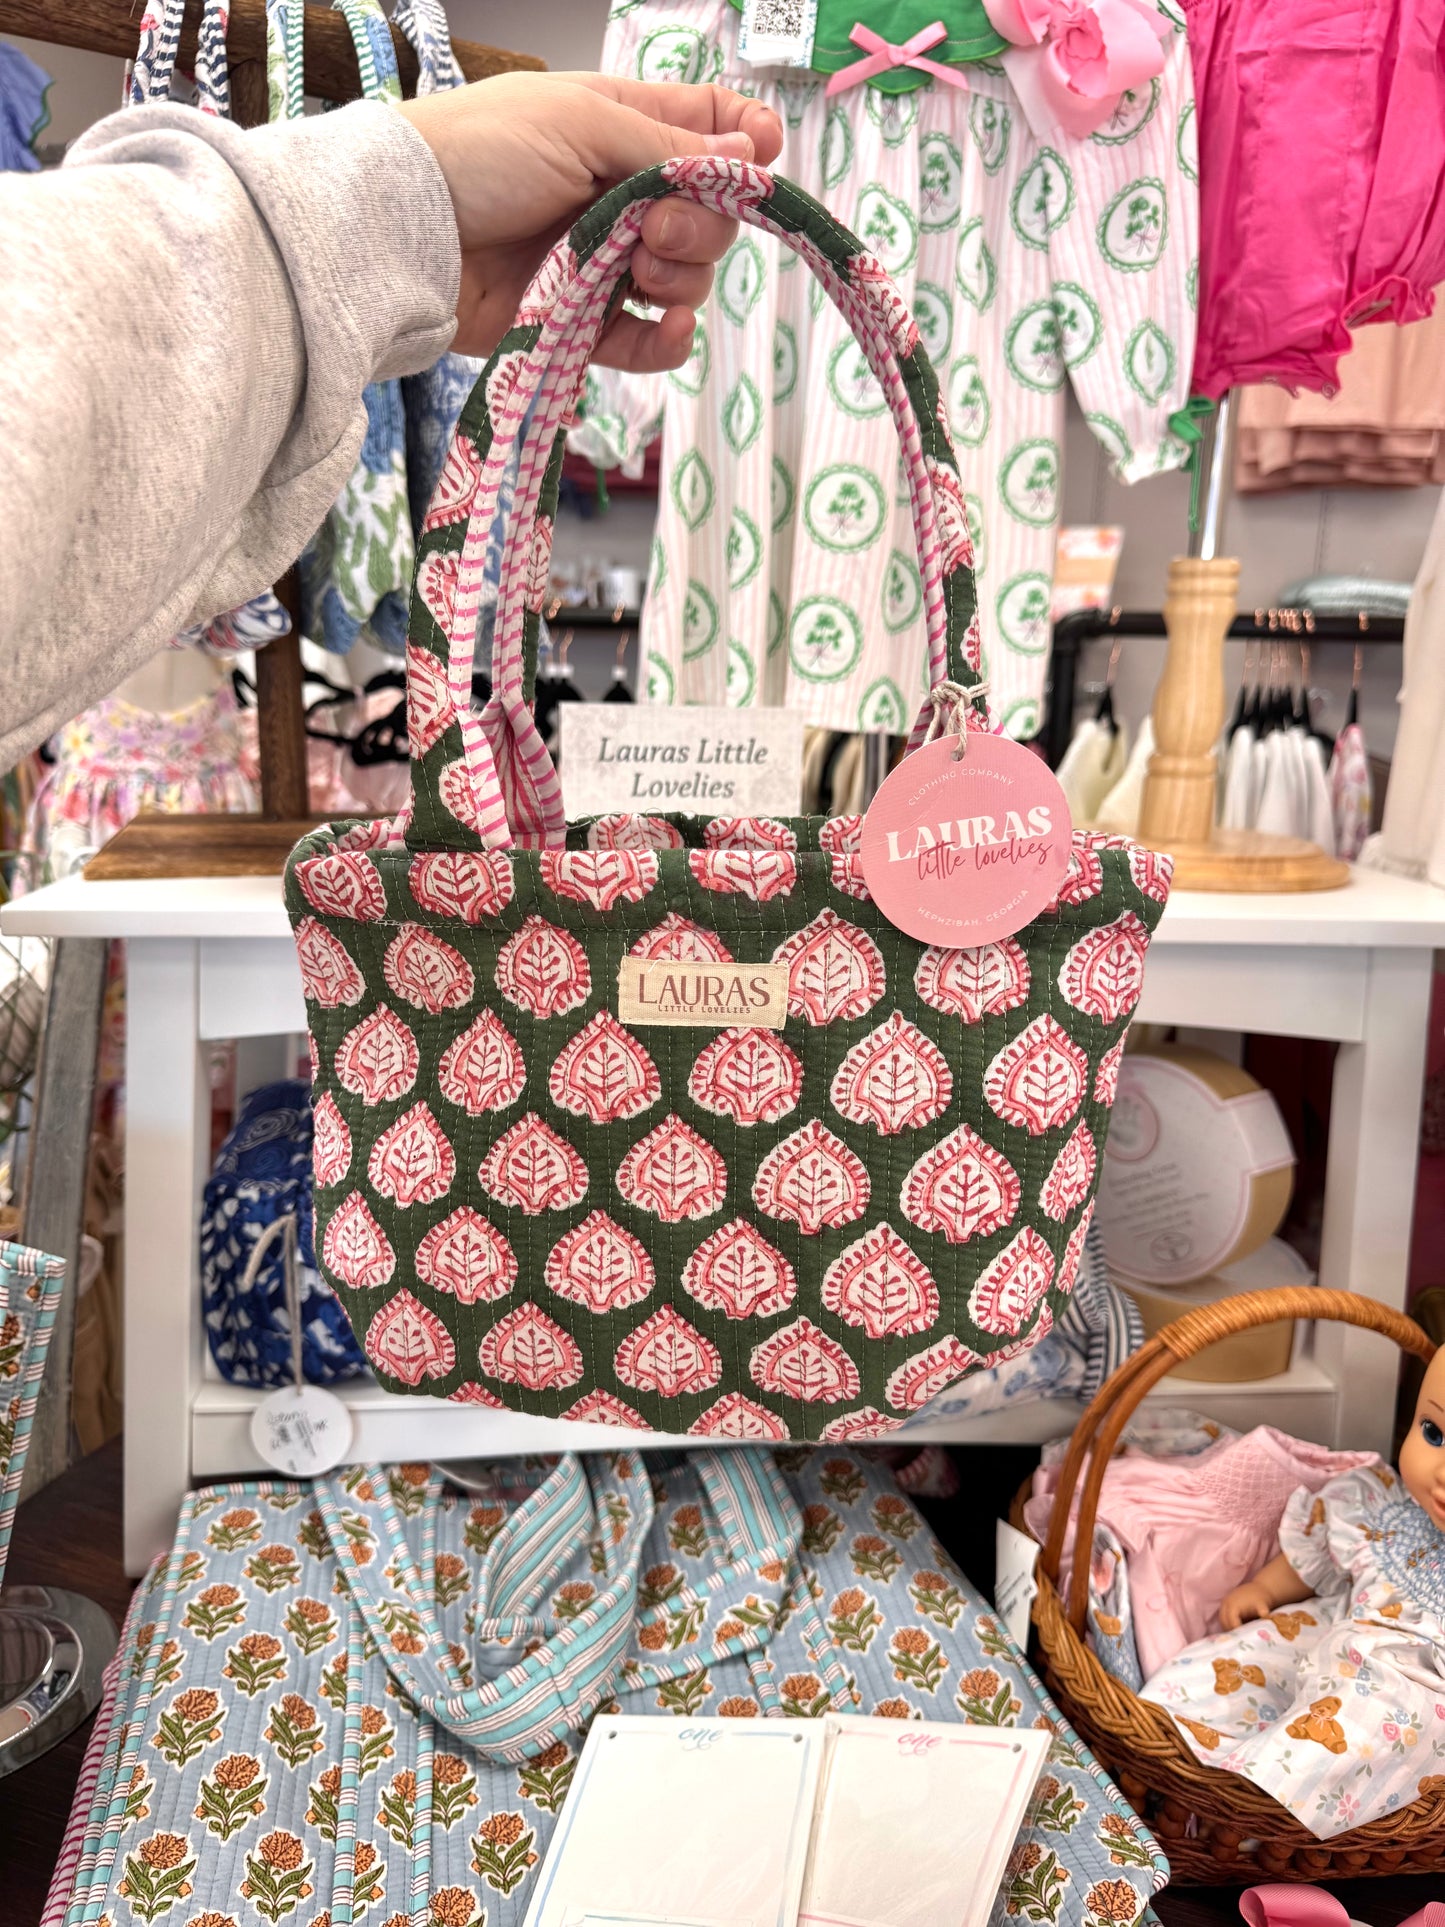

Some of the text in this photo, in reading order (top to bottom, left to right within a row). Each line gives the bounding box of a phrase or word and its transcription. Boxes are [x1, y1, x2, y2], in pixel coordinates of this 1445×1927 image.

[600, 737, 769, 764] Lauras Little
[631, 772, 735, 798] Lovelies
[909, 768, 1014, 806] CLOTHING COMPANY
[886, 806, 1054, 862] LAURAS
[918, 837, 1053, 880] little lovelies
[986, 889, 1029, 922] GEORGIA
[639, 973, 771, 1007] LAURAS
[658, 1005, 751, 1014] LITTLE LOVELIES
